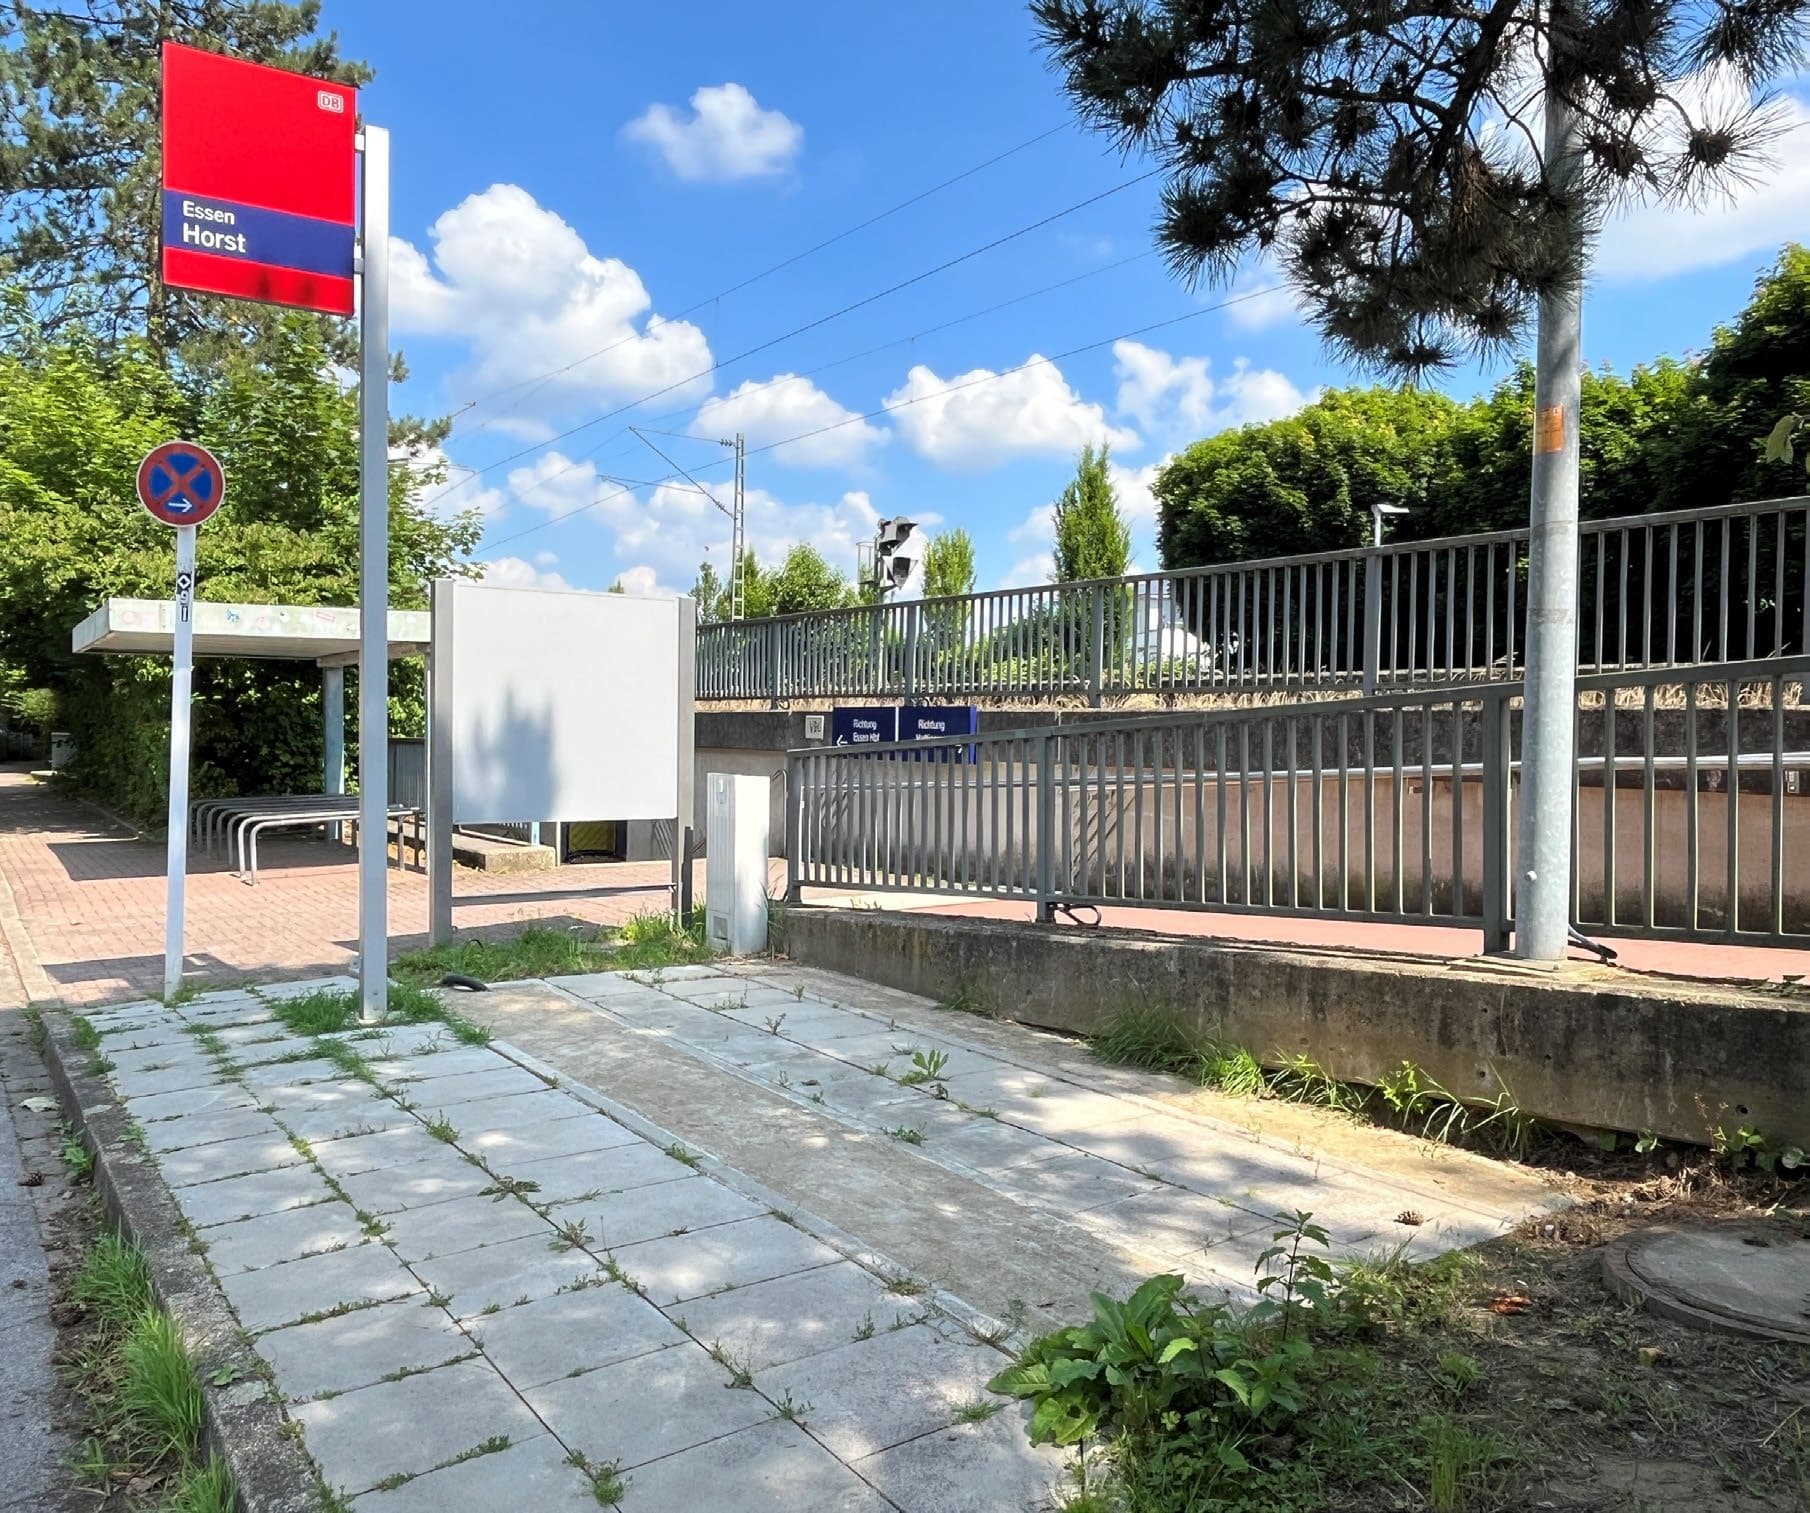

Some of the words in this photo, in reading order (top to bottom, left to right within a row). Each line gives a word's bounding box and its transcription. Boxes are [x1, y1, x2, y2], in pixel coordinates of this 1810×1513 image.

[321, 93, 341, 110] DB
[183, 200, 235, 225] Essen
[183, 222, 247, 253] Horst
[853, 719, 877, 731] Richtung
[918, 719, 945, 732] Richtung
